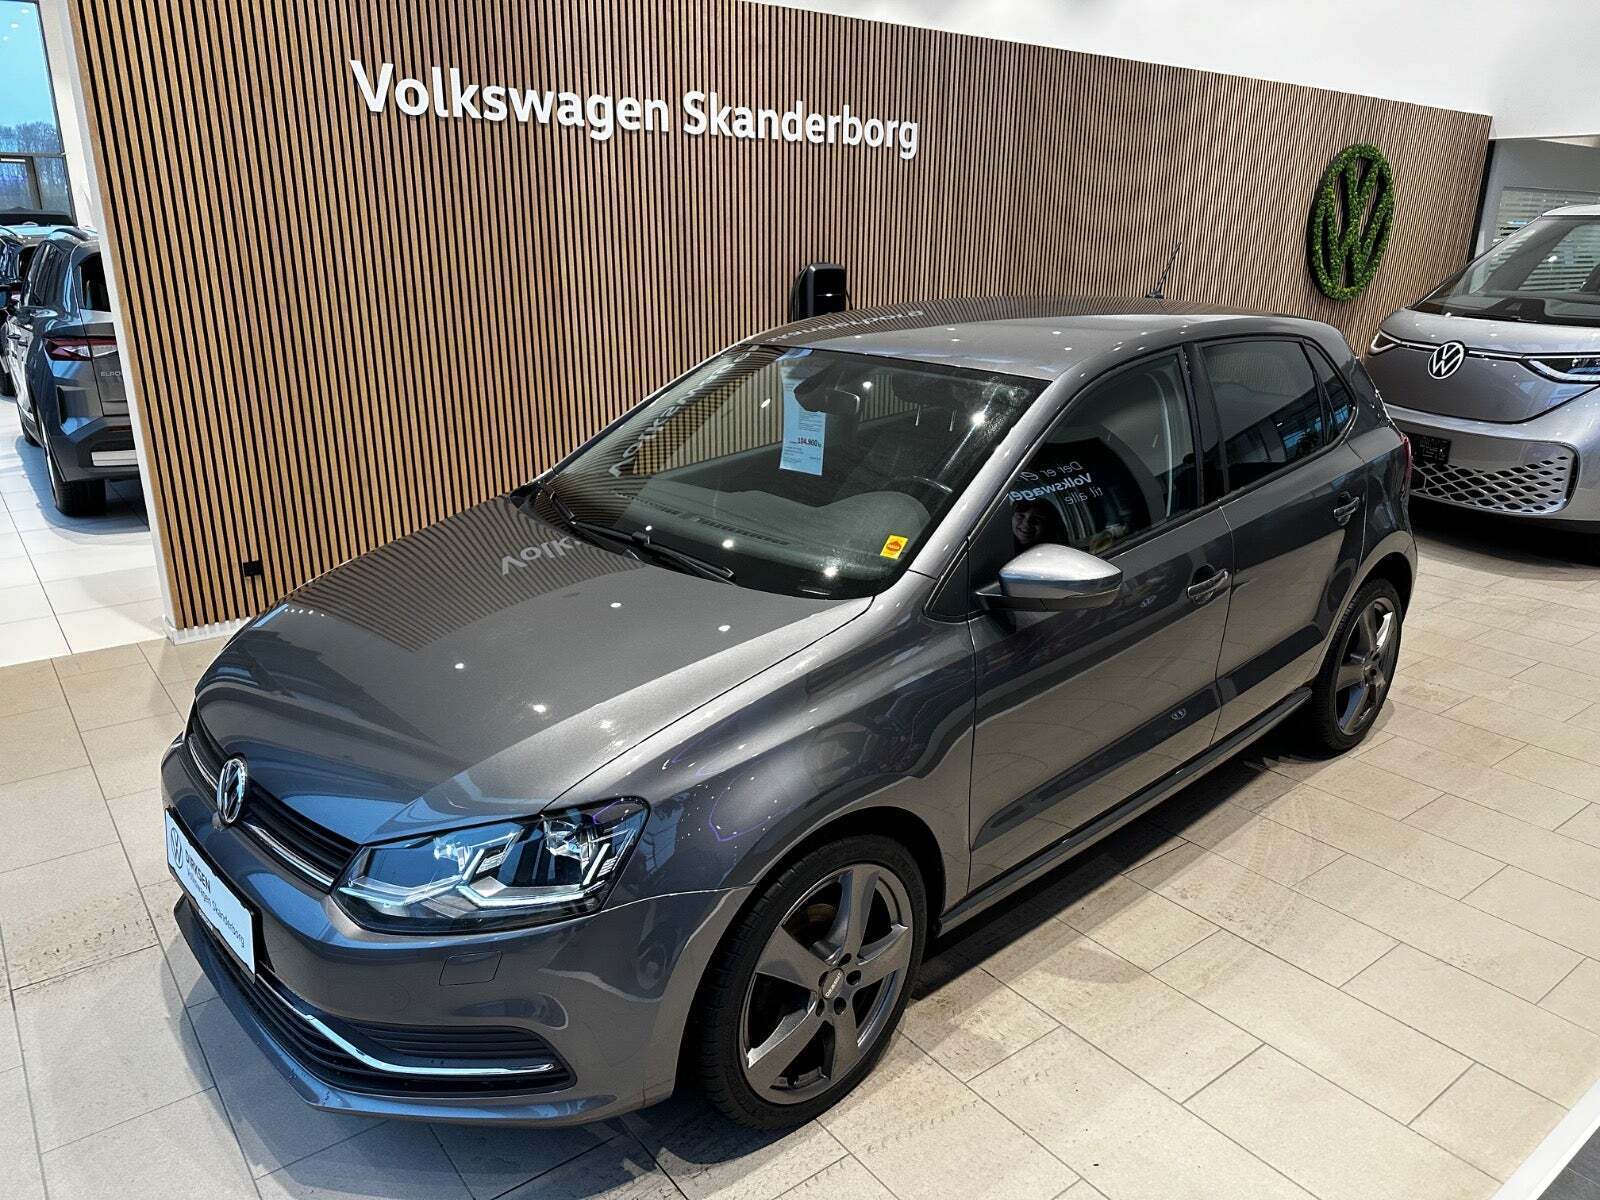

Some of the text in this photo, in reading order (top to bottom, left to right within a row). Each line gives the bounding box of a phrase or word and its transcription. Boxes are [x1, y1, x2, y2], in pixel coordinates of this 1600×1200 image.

[350, 59, 918, 160] Volkswagen Skanderborg
[211, 899, 246, 949] Skanderborg
